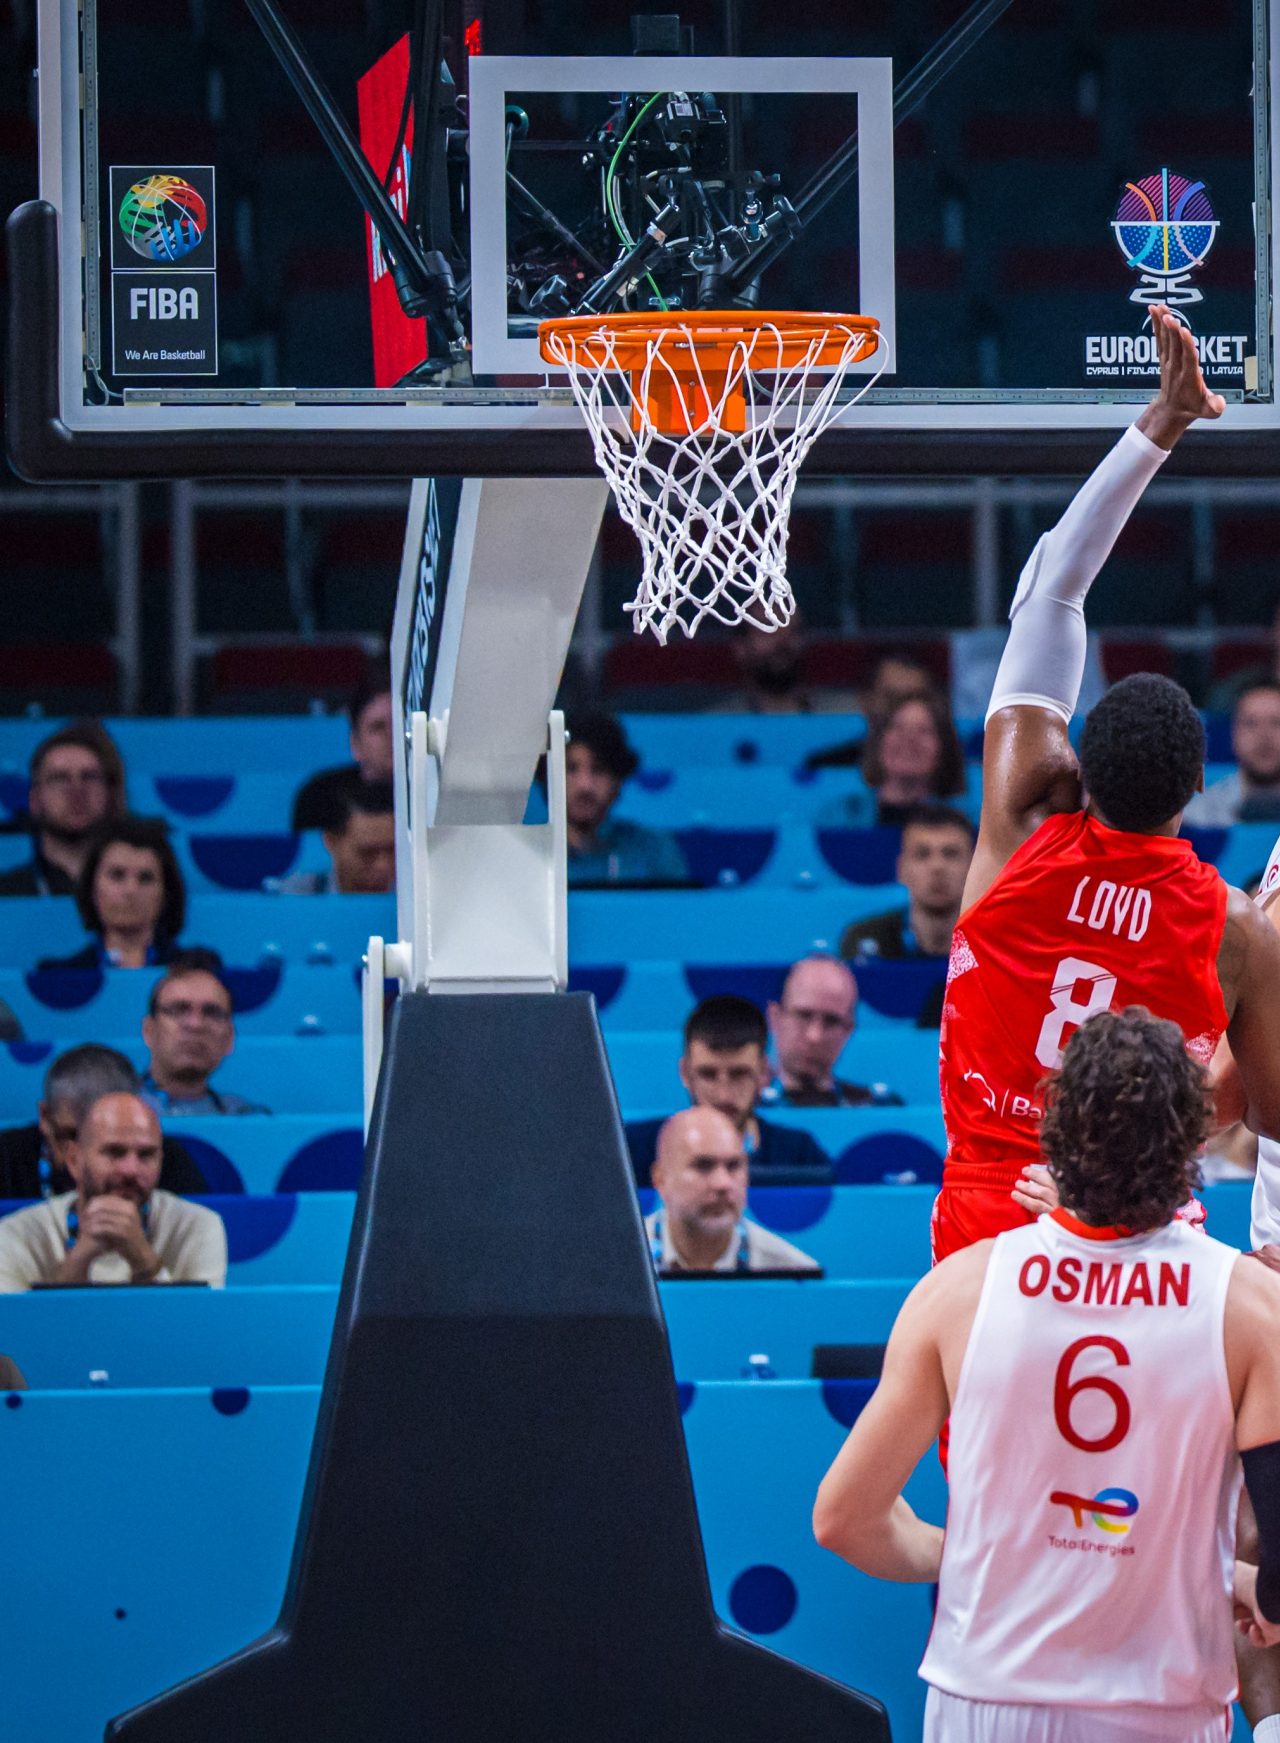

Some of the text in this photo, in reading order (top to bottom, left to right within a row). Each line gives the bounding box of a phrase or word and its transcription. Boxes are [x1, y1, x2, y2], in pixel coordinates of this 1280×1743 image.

[130, 287, 199, 320] FIBA
[125, 350, 206, 360] We Are Basketball
[1086, 335, 1248, 364] EUROKET
[1086, 366, 1119, 375] CYPRUS
[1211, 366, 1244, 375] LATVIA
[1067, 875, 1152, 942] LOYD
[1034, 956, 1118, 1070] 8
[1011, 1095, 1047, 1120] Ba
[1018, 1254, 1191, 1306] OSMAN
[1053, 1335, 1131, 1453] 6
